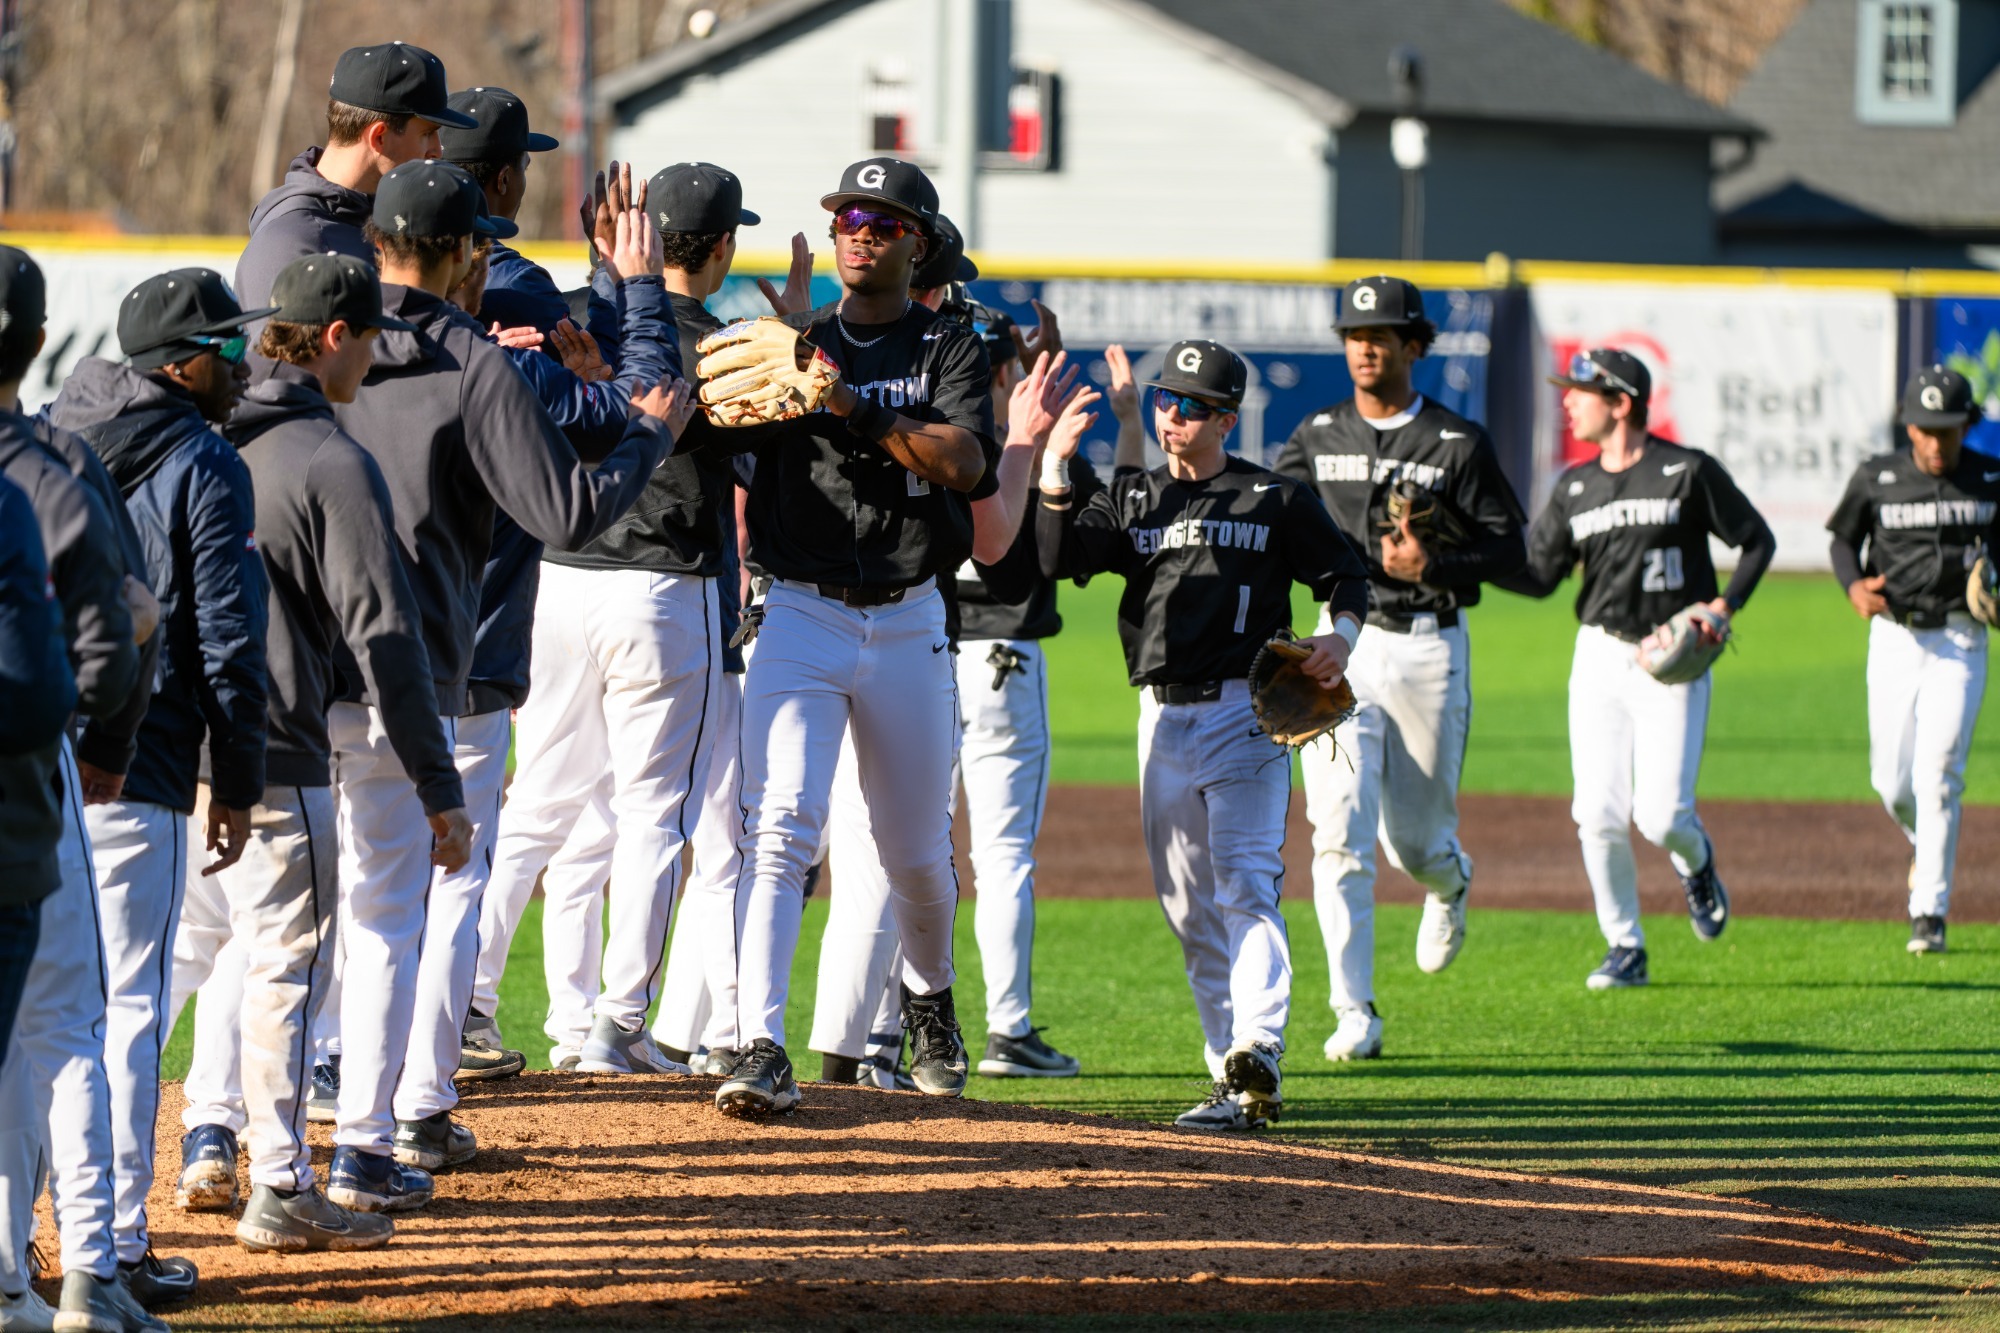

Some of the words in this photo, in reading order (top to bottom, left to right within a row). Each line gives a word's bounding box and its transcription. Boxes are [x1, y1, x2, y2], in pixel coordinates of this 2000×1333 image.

[857, 164, 887, 190] G
[1352, 286, 1377, 311] G
[1176, 347, 1203, 374] G
[1642, 546, 1685, 592] 20
[1233, 585, 1250, 633] 1
